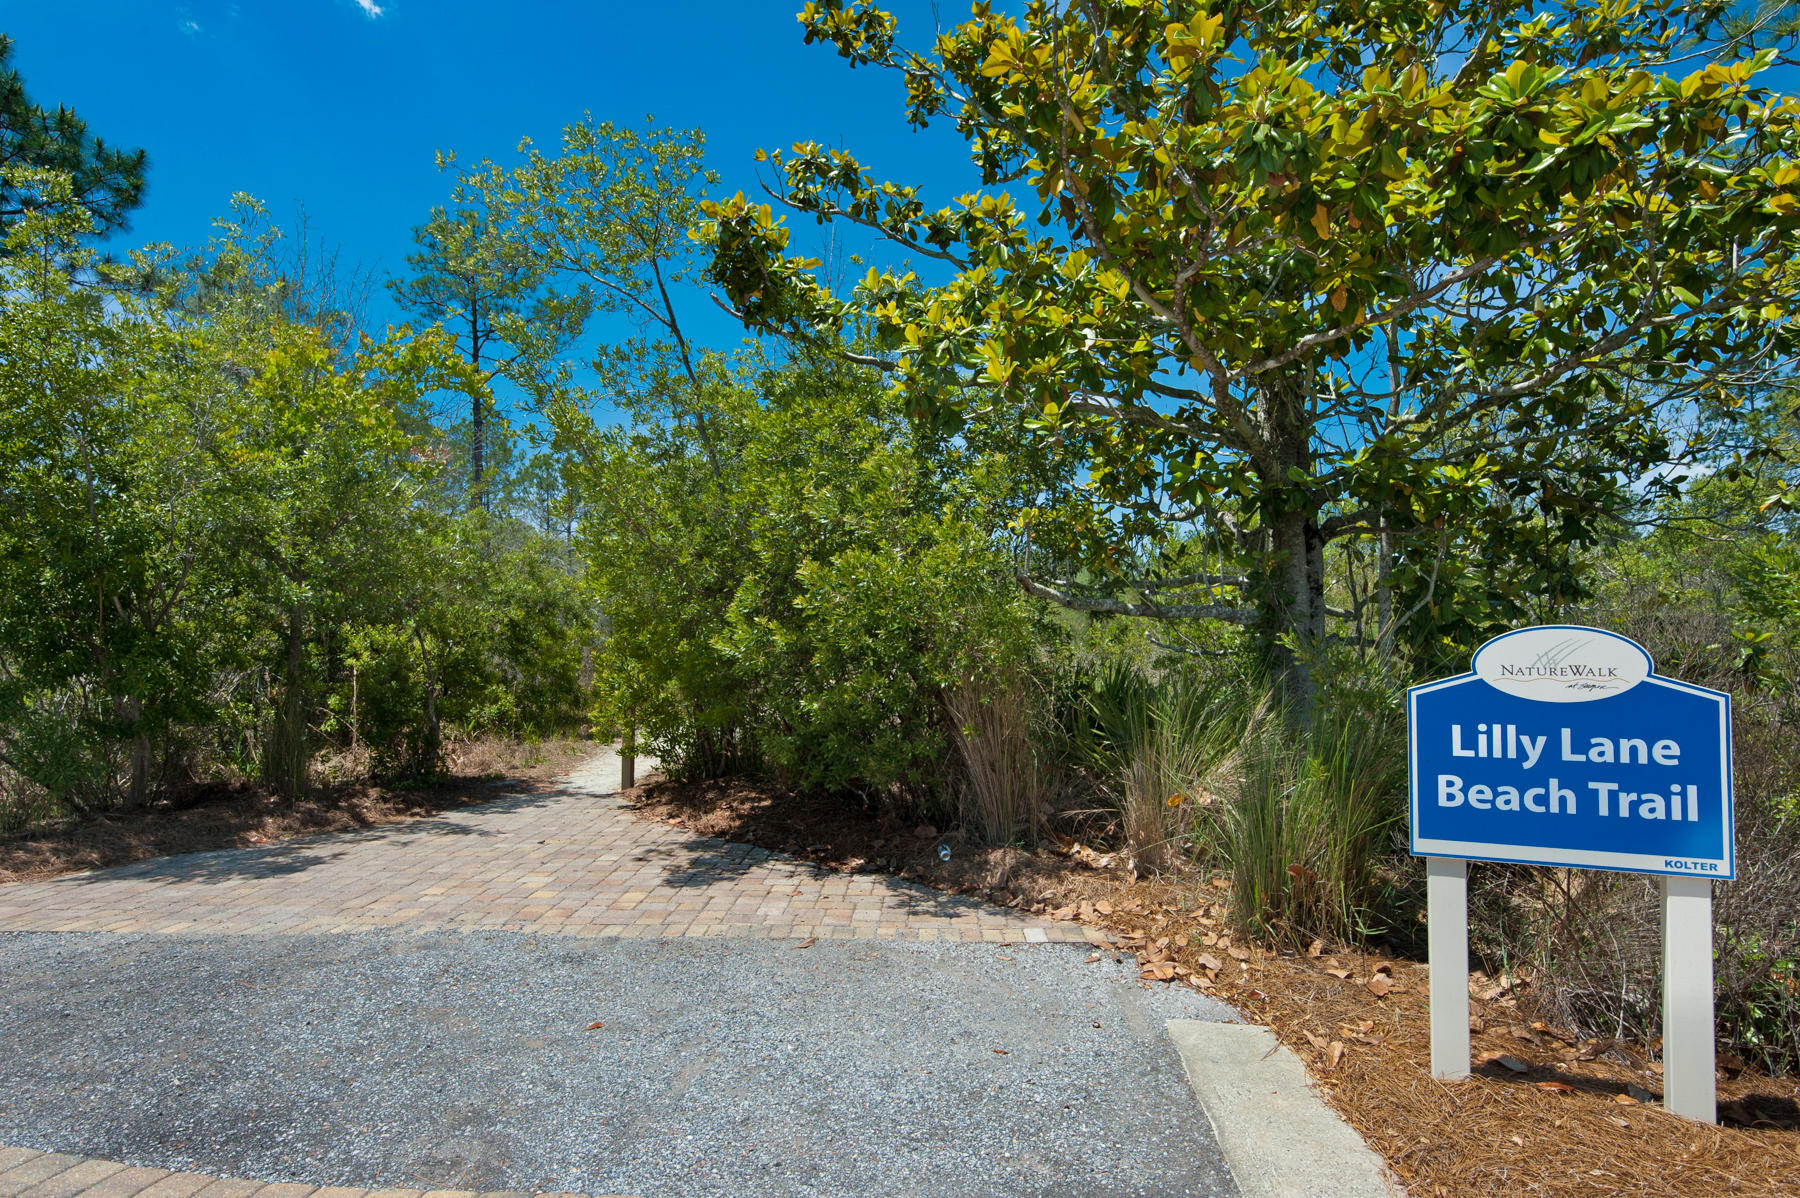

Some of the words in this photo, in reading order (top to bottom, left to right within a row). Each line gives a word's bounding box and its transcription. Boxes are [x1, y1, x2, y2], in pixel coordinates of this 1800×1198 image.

[1451, 723, 1547, 770] Lilly
[1561, 727, 1681, 766] Lane
[1437, 774, 1577, 815] Beach
[1587, 781, 1699, 822] Trail
[1664, 859, 1718, 872] KOLTER
